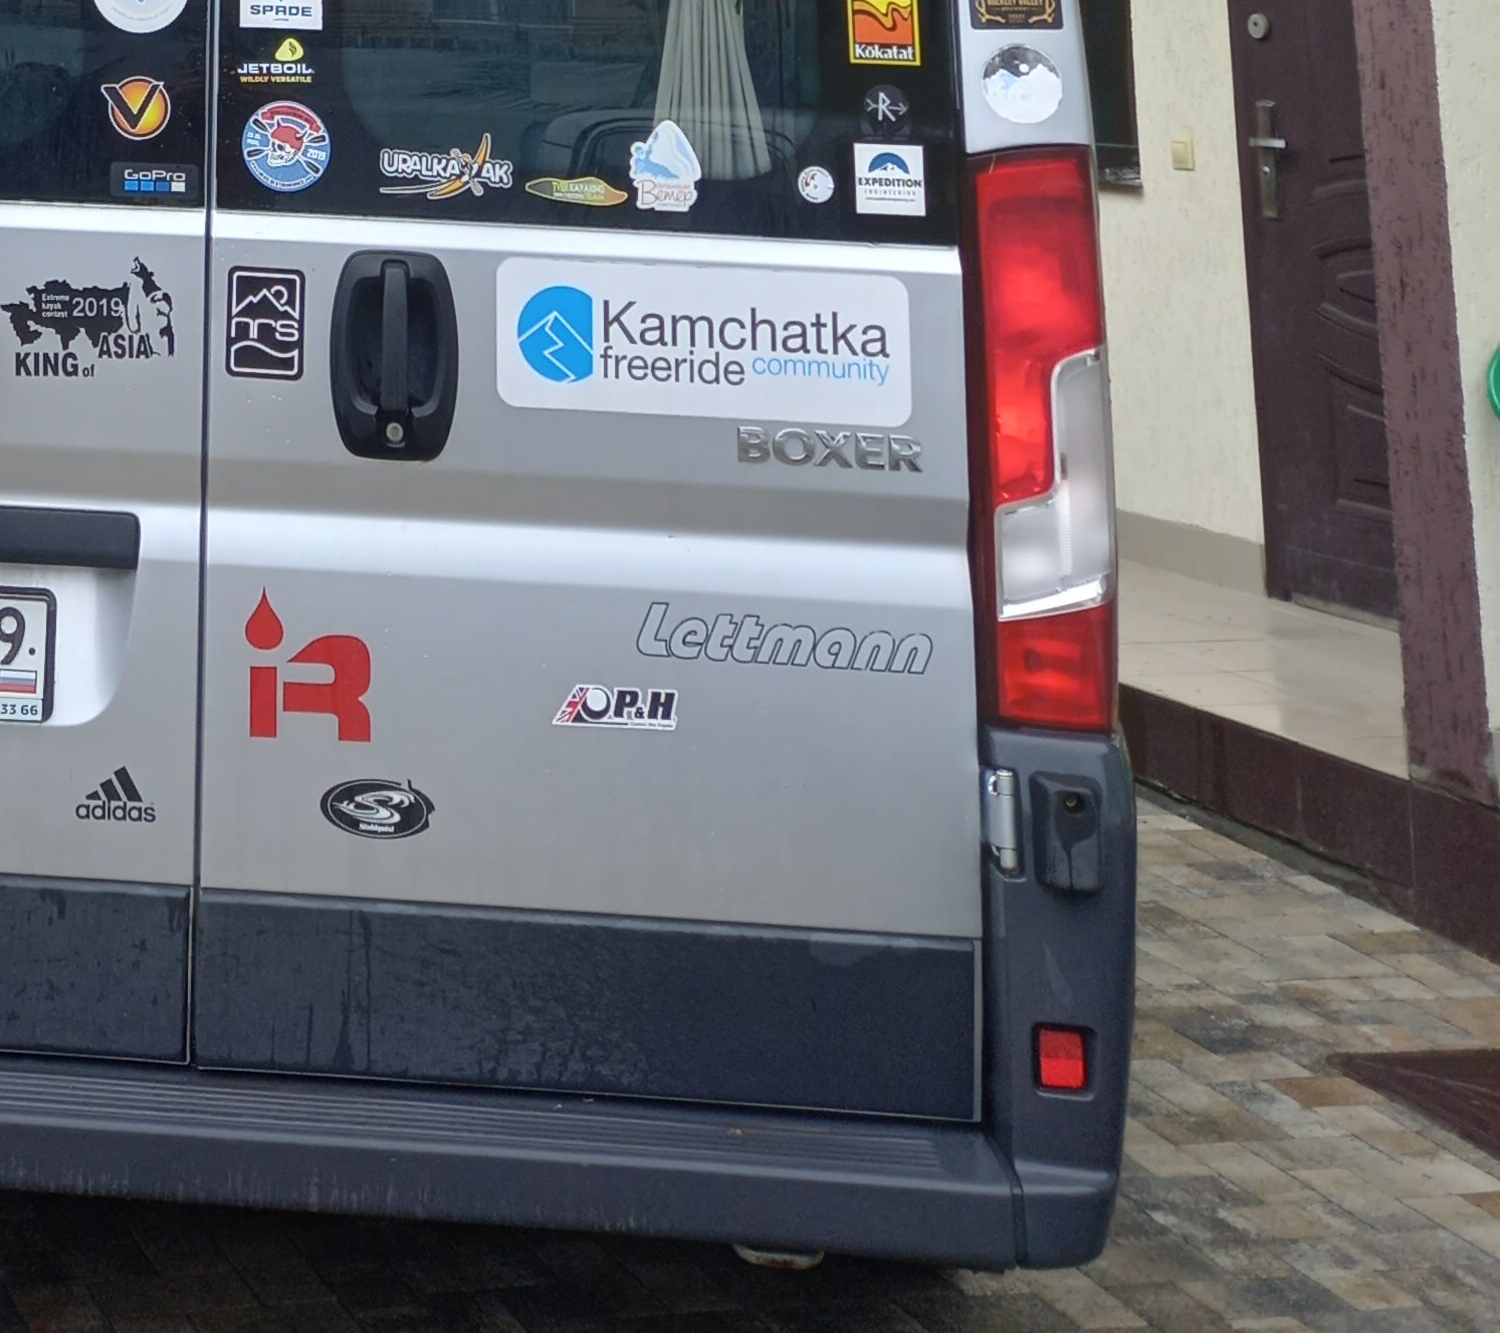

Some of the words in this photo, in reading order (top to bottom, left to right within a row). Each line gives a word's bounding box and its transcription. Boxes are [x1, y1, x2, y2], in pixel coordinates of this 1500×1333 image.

[250, 5, 312, 17] SPADE
[237, 63, 313, 74] JETBOIL
[124, 169, 186, 181] GoPro
[858, 177, 921, 188] EXPEDITION
[42, 293, 70, 301] Extreme
[72, 297, 124, 317] 2019
[231, 318, 299, 342] nrs
[602, 299, 890, 359] Kamchatka
[15, 352, 78, 377] KING
[83, 363, 95, 377] of
[98, 333, 151, 359] ASIA
[600, 346, 746, 386] freeride
[752, 355, 891, 387] community
[737, 425, 923, 473] BOXER
[637, 602, 933, 674] Lettmann
[0, 703, 17, 716] 33
[20, 704, 38, 717] 66
[613, 689, 676, 721] P&H
[75, 799, 156, 823] adidas
